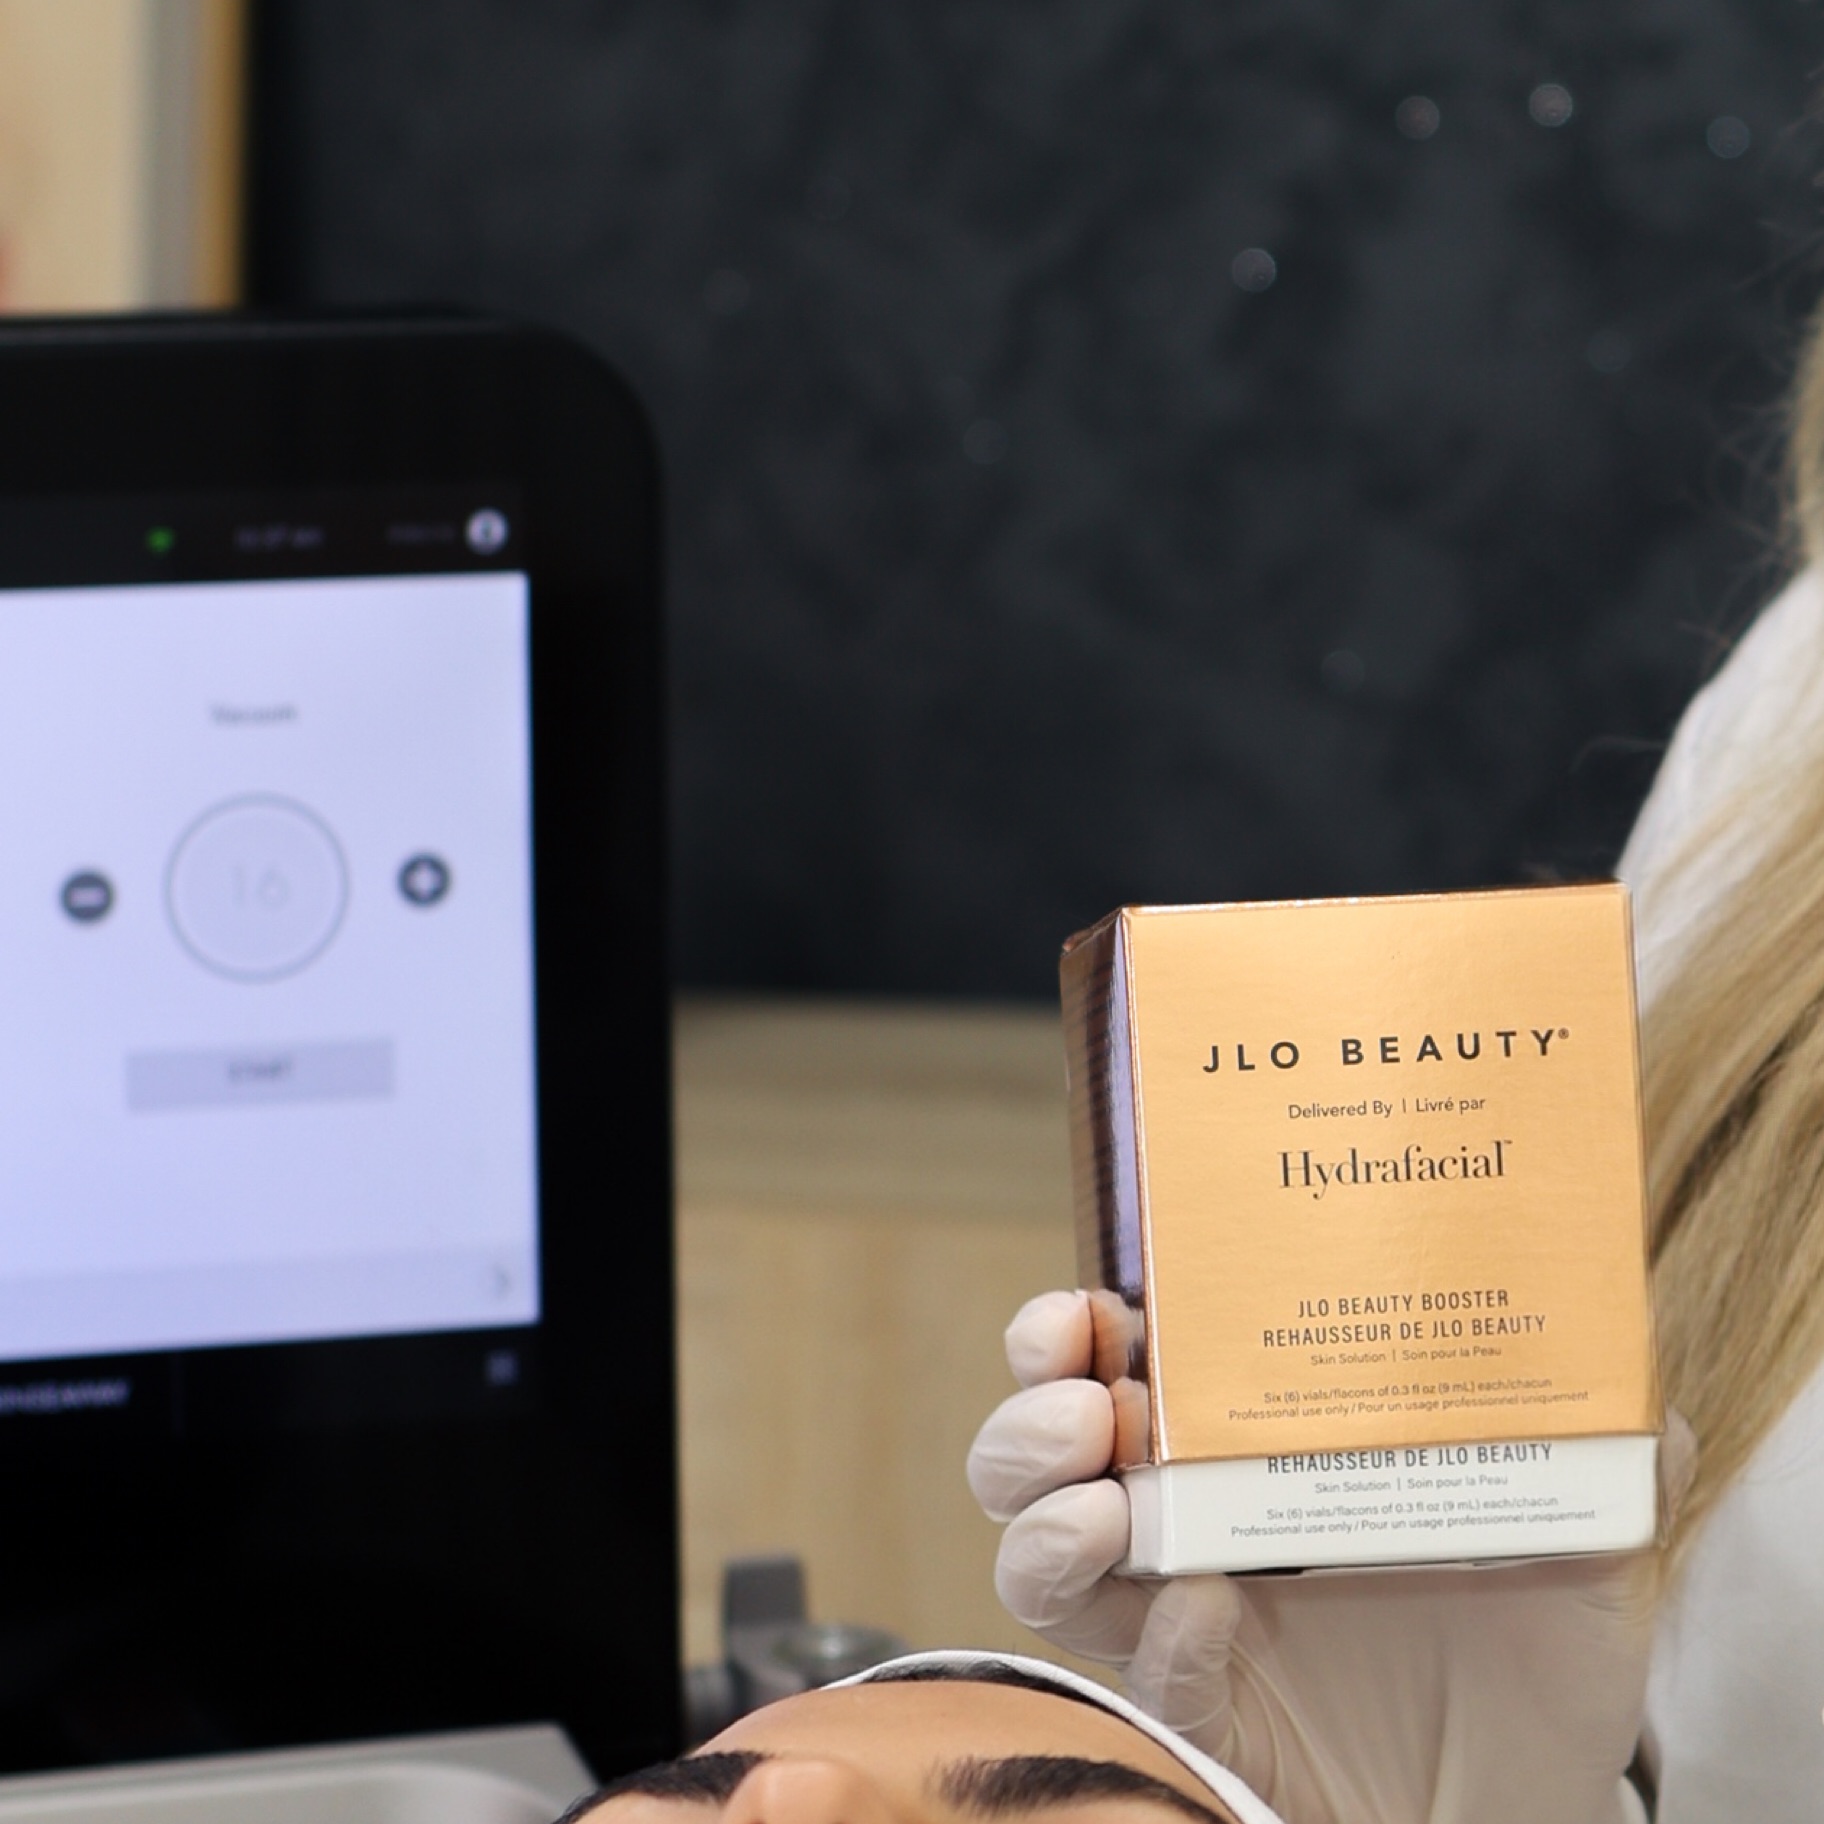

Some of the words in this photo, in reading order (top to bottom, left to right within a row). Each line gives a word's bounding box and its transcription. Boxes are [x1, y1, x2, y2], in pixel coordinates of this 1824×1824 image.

[1202, 1041, 1299, 1073] JLO
[1288, 1101, 1367, 1119] Delivered
[1373, 1100, 1393, 1118] By
[1415, 1097, 1454, 1113] Livré
[1459, 1098, 1486, 1115] par
[1298, 1298, 1330, 1318] JLO
[1339, 1294, 1413, 1316] BEAUTY
[1422, 1289, 1509, 1311] BOOSTER
[1263, 1323, 1392, 1348] REHAUSSEUR
[1400, 1321, 1423, 1340] DE
[1432, 1319, 1463, 1339] JLO
[1472, 1315, 1546, 1336] BEAUTY
[1310, 1353, 1336, 1366] Skin
[1339, 1351, 1386, 1365] Solution
[1402, 1348, 1428, 1361] Soin
[1431, 1349, 1456, 1361] pour
[1460, 1347, 1470, 1357] la
[1473, 1345, 1502, 1357] Peau
[1264, 1392, 1281, 1404] Six
[1284, 1391, 1300, 1405] (6)
[1302, 1387, 1375, 1402] vials/flacons
[1377, 1385, 1389, 1397] of
[1391, 1384, 1409, 1396] 0.3
[1422, 1384, 1436, 1394] oz
[1477, 1378, 1552, 1392] each/chacun
[1228, 1407, 1299, 1421] Professional
[1302, 1407, 1322, 1416] use
[1325, 1404, 1349, 1417] only
[1358, 1401, 1384, 1414] Pour
[1387, 1402, 1401, 1412] un
[1405, 1399, 1439, 1412] usage
[1442, 1395, 1518, 1410] professionnel
[1521, 1391, 1589, 1406] uniquement
[1267, 1450, 1397, 1474] REHAUSSEUR
[1405, 1448, 1429, 1467] DE
[1437, 1446, 1469, 1466] JLO
[1477, 1443, 1553, 1464] BEAUTY
[1315, 1481, 1340, 1494] Skin
[1343, 1479, 1391, 1493] Solution
[1407, 1477, 1433, 1489] Soin
[1436, 1477, 1462, 1489] pour
[1466, 1475, 1476, 1486] la
[1479, 1474, 1508, 1486] Peau
[1267, 1508, 1284, 1520] Six
[1287, 1507, 1303, 1521] (6)
[1305, 1504, 1378, 1518] vials/flacons
[1381, 1502, 1393, 1514] of
[1395, 1501, 1414, 1513] 0.3
[1426, 1503, 1440, 1513] oz
[1483, 1496, 1558, 1510] each/chacun
[1231, 1523, 1301, 1537] Professional
[1304, 1524, 1325, 1534] use
[1328, 1521, 1351, 1534] only
[1361, 1519, 1388, 1531] Pour
[1391, 1520, 1406, 1529] un
[1410, 1517, 1443, 1530] usage
[1447, 1513, 1524, 1528] professionnel
[1527, 1509, 1595, 1523] uniquement
